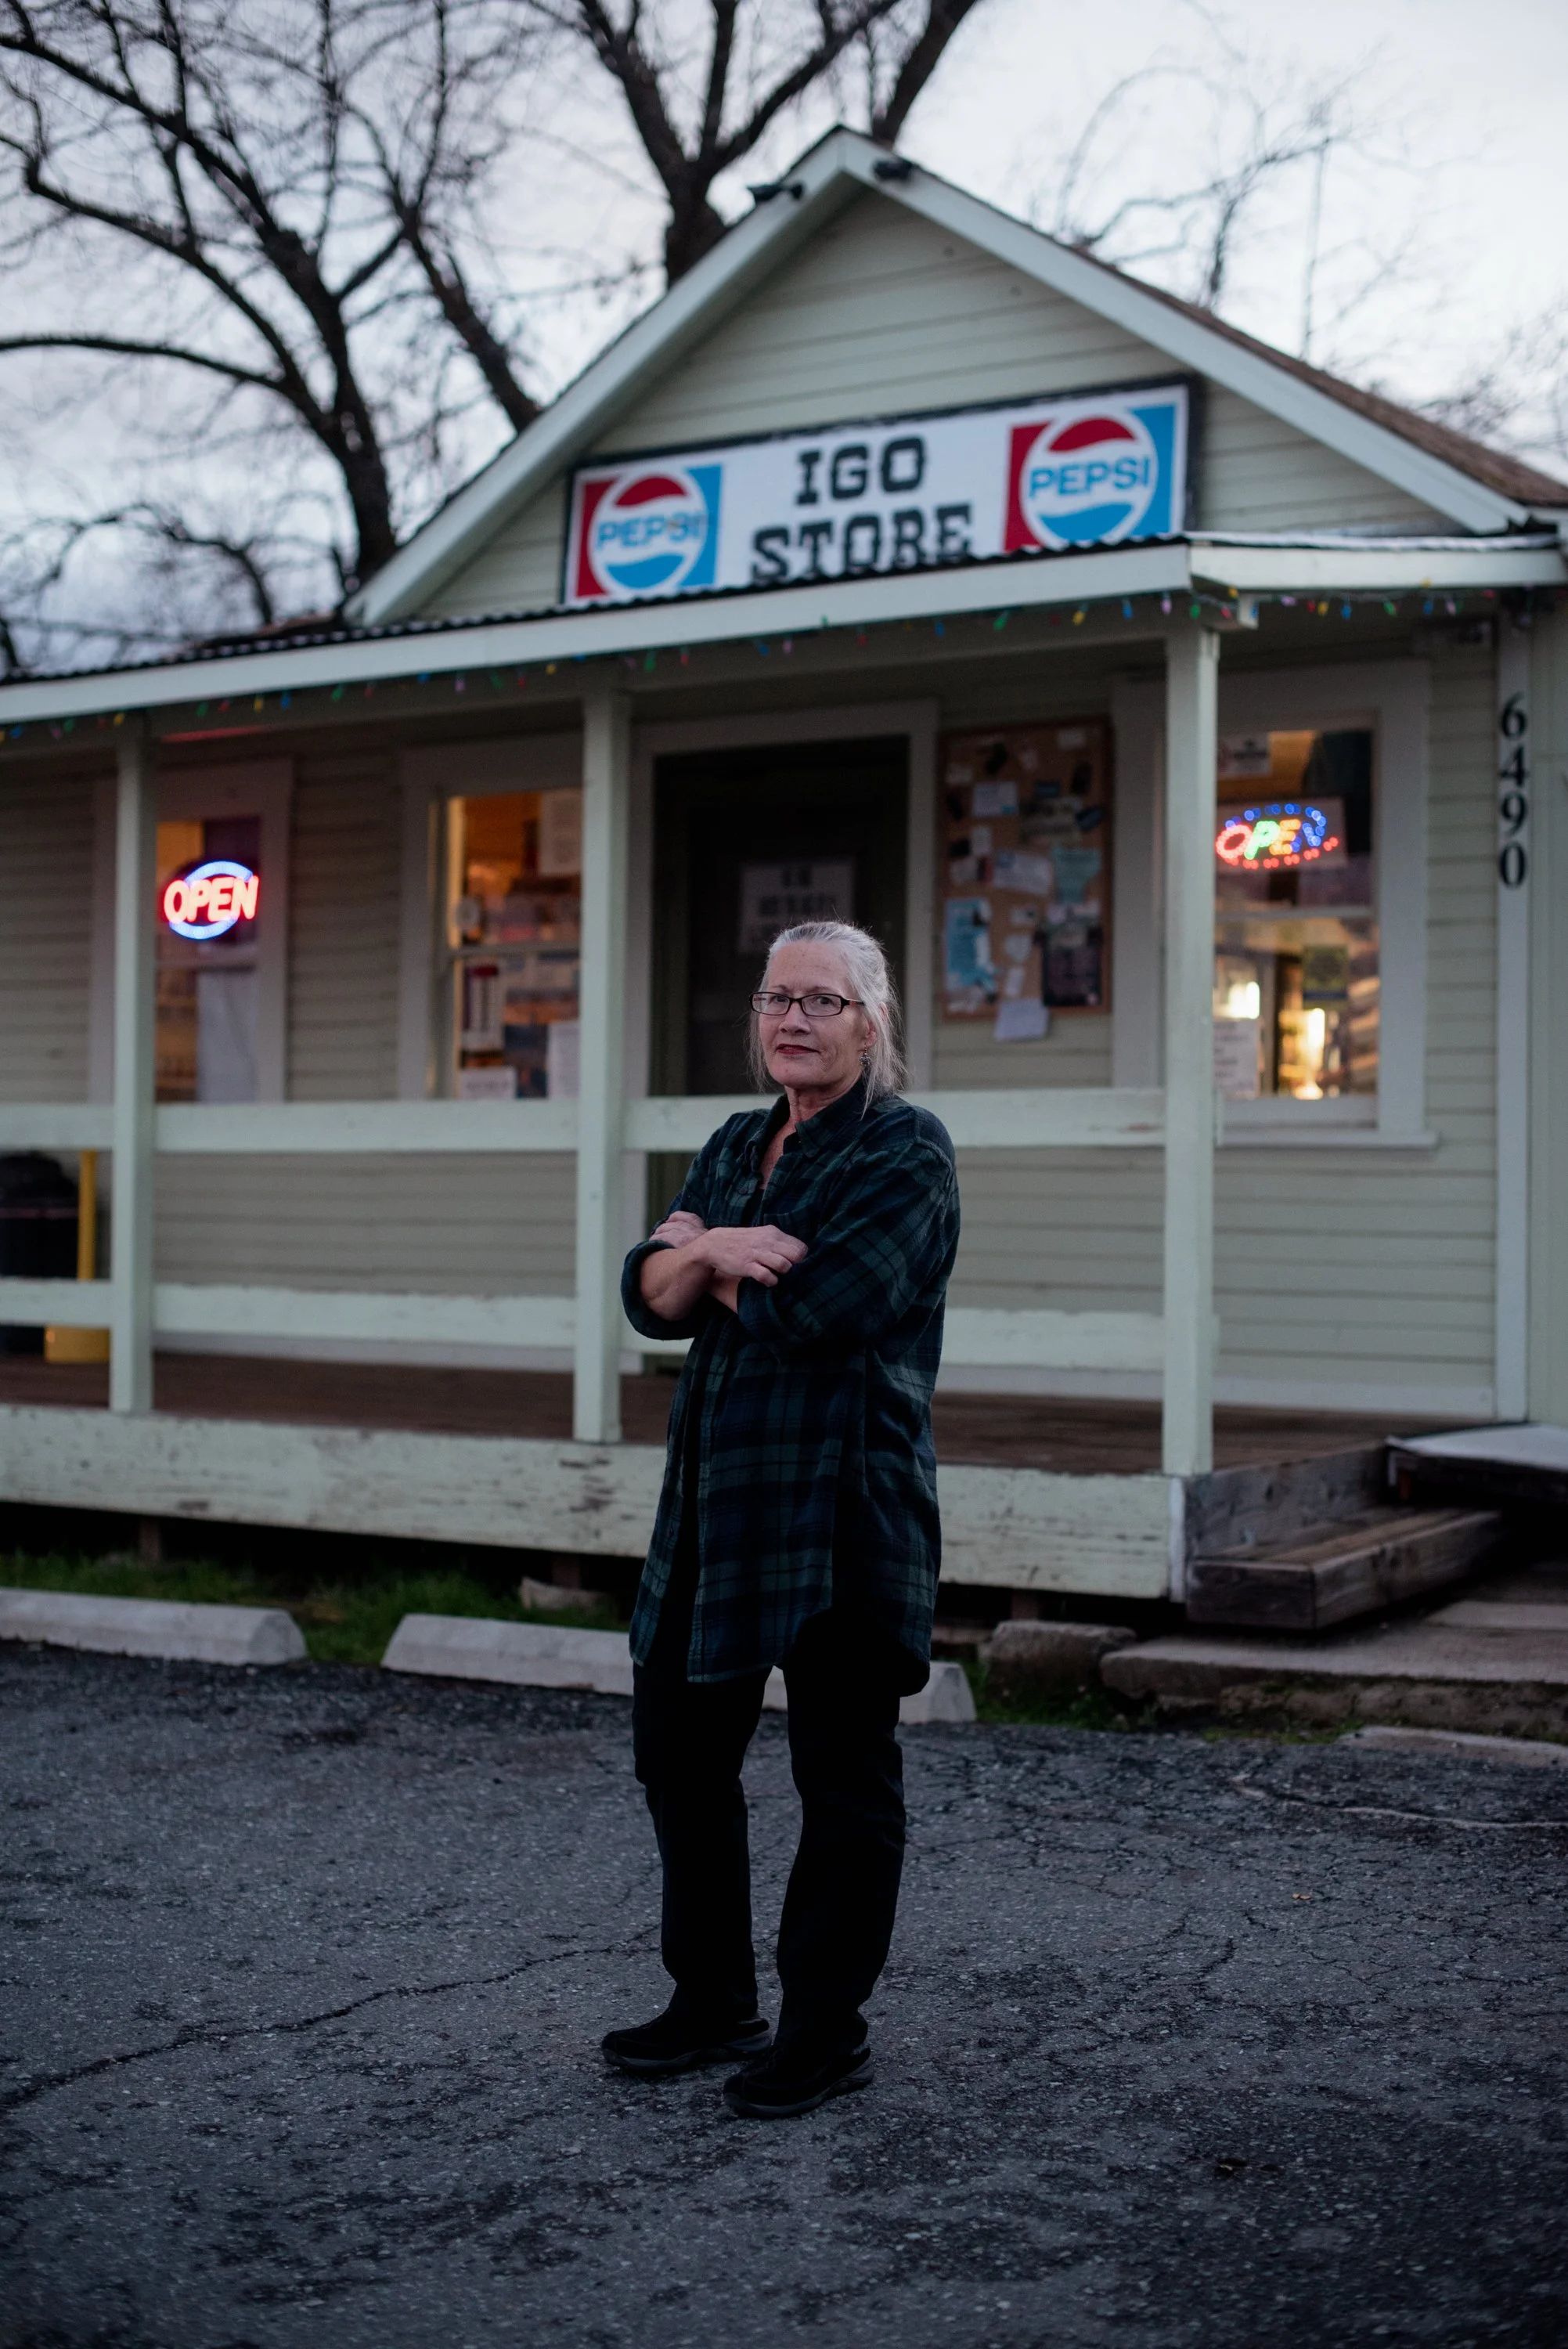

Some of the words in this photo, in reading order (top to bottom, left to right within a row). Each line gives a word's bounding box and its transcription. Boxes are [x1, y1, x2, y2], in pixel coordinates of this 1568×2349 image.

[795, 436, 925, 506] IGO
[1029, 456, 1150, 499] PEPSI
[596, 511, 707, 551] PEPSI
[752, 503, 971, 579] STORE
[1499, 691, 1528, 889] 6490
[1216, 814, 1327, 861] OPEN
[163, 875, 259, 925] OPEN
